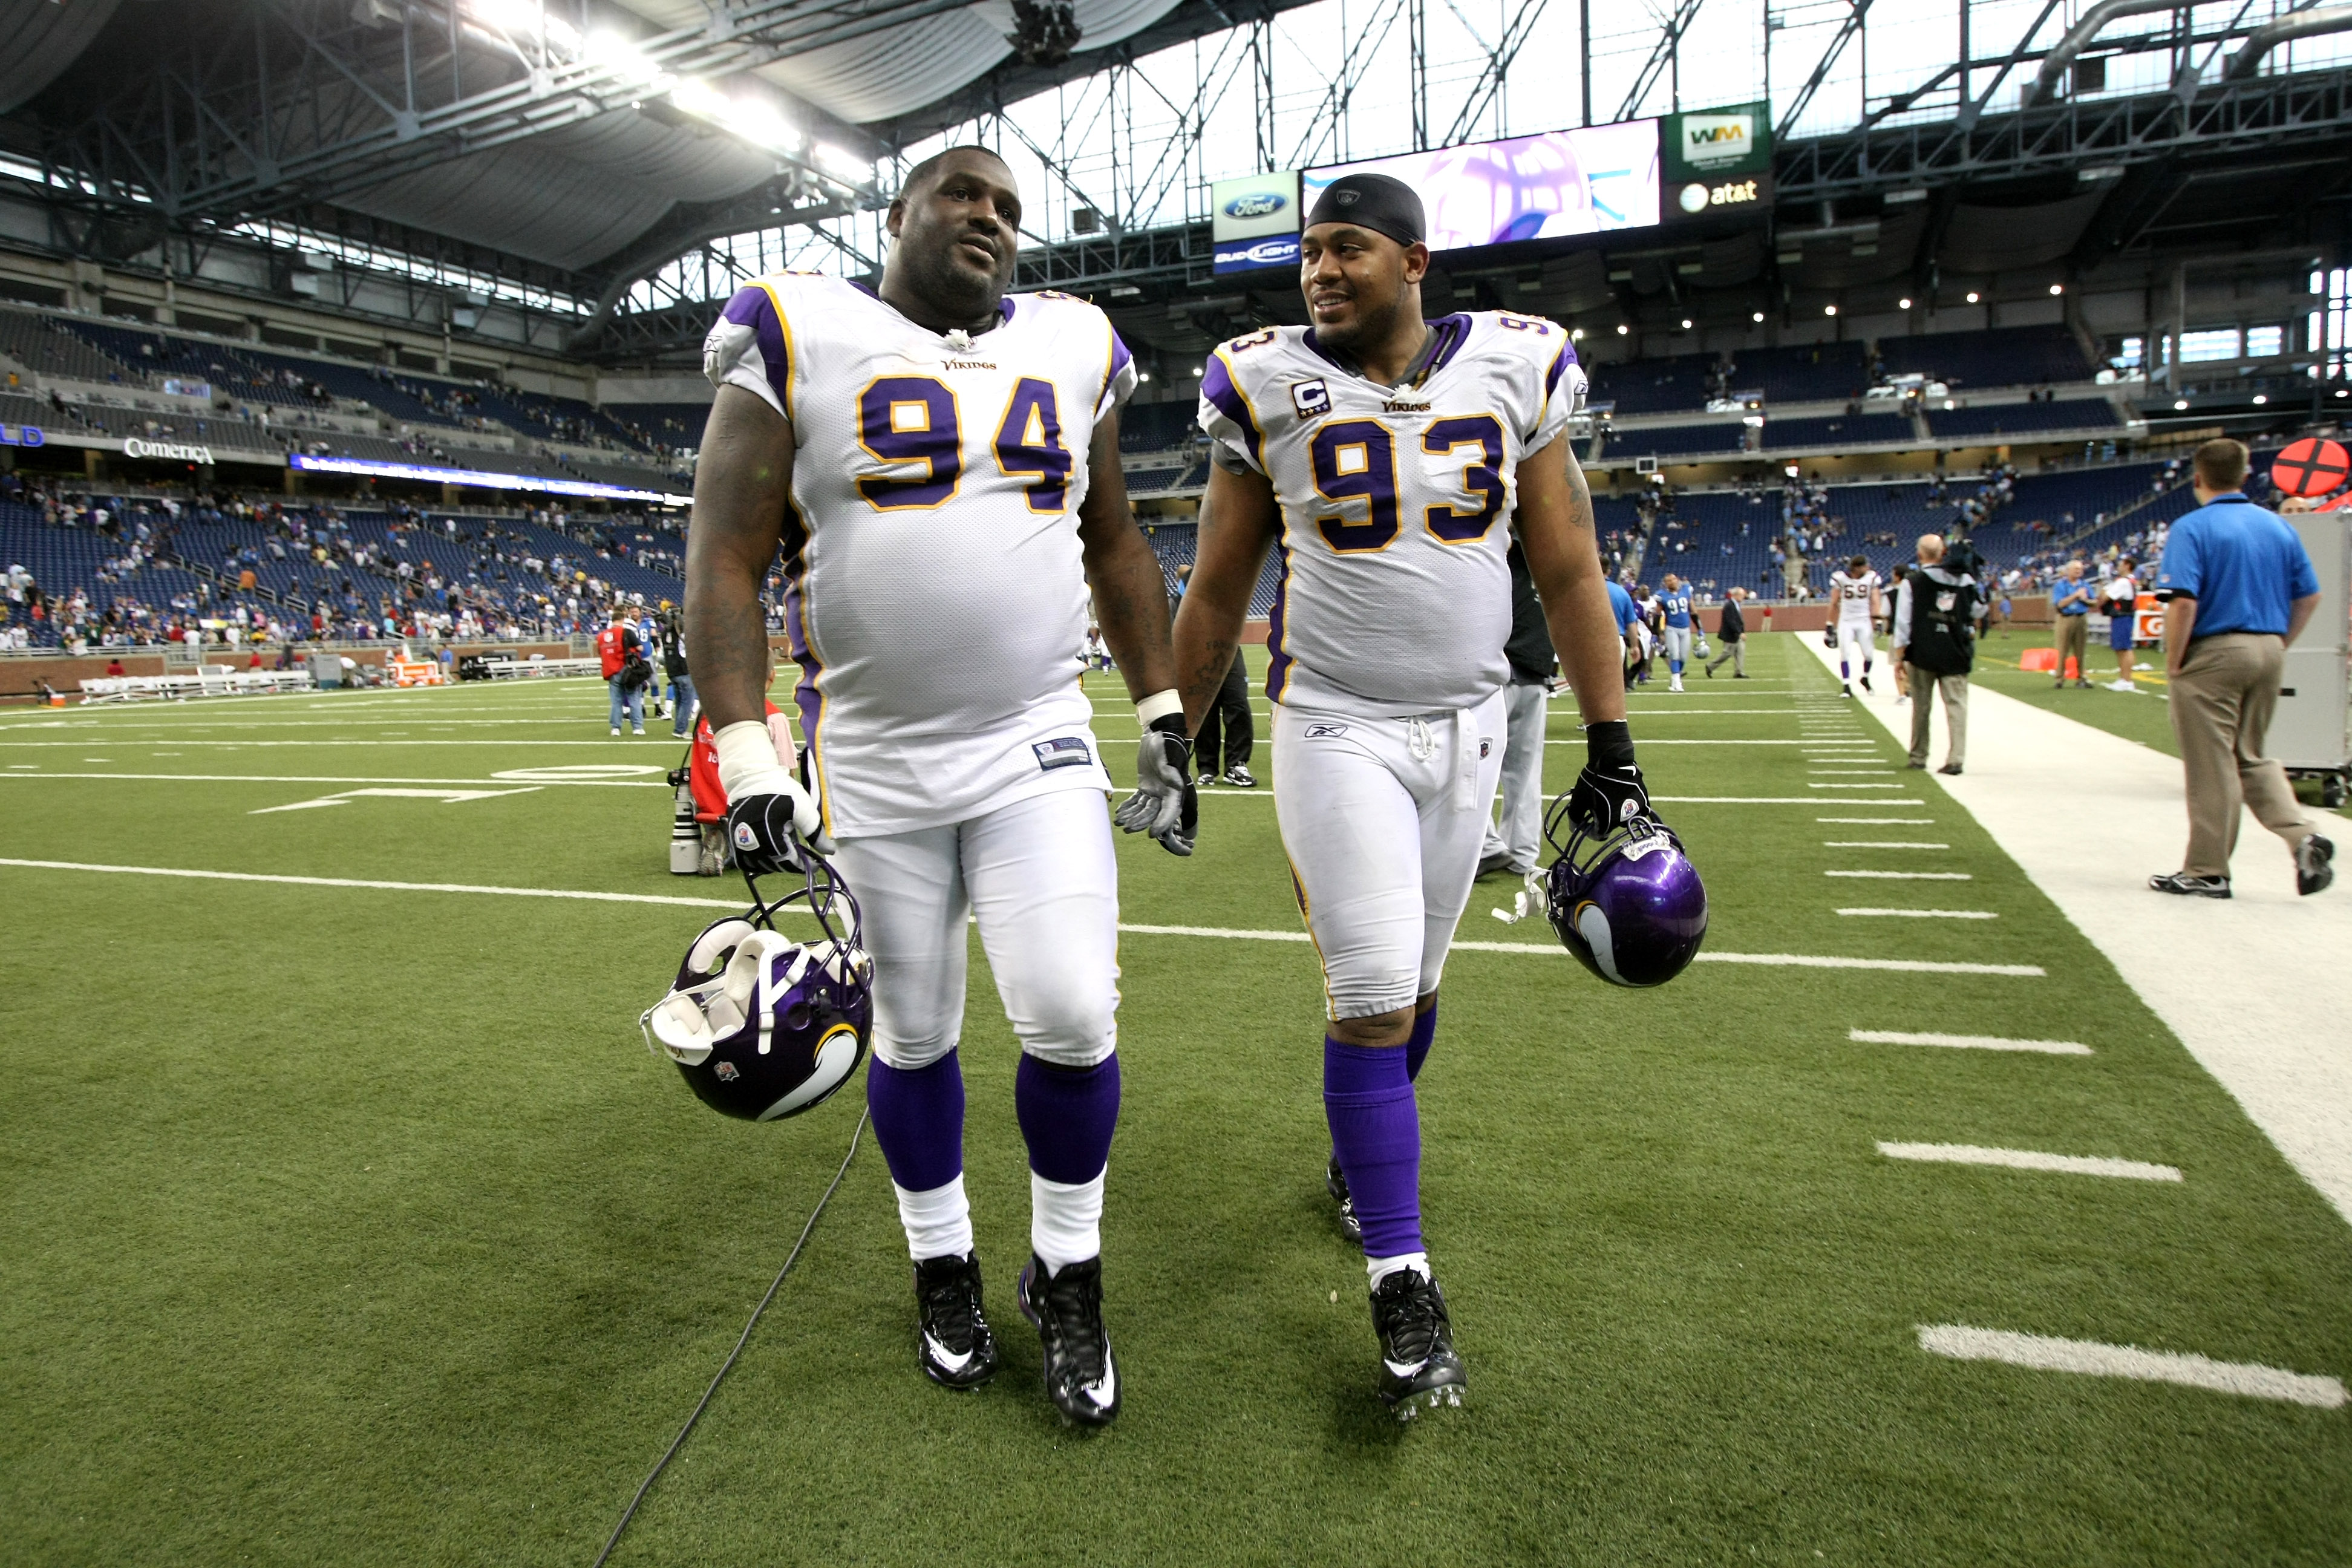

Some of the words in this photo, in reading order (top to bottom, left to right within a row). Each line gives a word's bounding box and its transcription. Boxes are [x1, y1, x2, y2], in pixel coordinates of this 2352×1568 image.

[1691, 125, 1743, 144] WM
[1711, 180, 1757, 205] at&t
[1234, 195, 1276, 217] Ford
[1214, 251, 1247, 263] BUD
[1257, 244, 1299, 258] LIGHT
[1293, 381, 1327, 410] C
[855, 374, 1074, 515] 94
[1307, 412, 1508, 555] 93
[1667, 597, 1688, 615] 99
